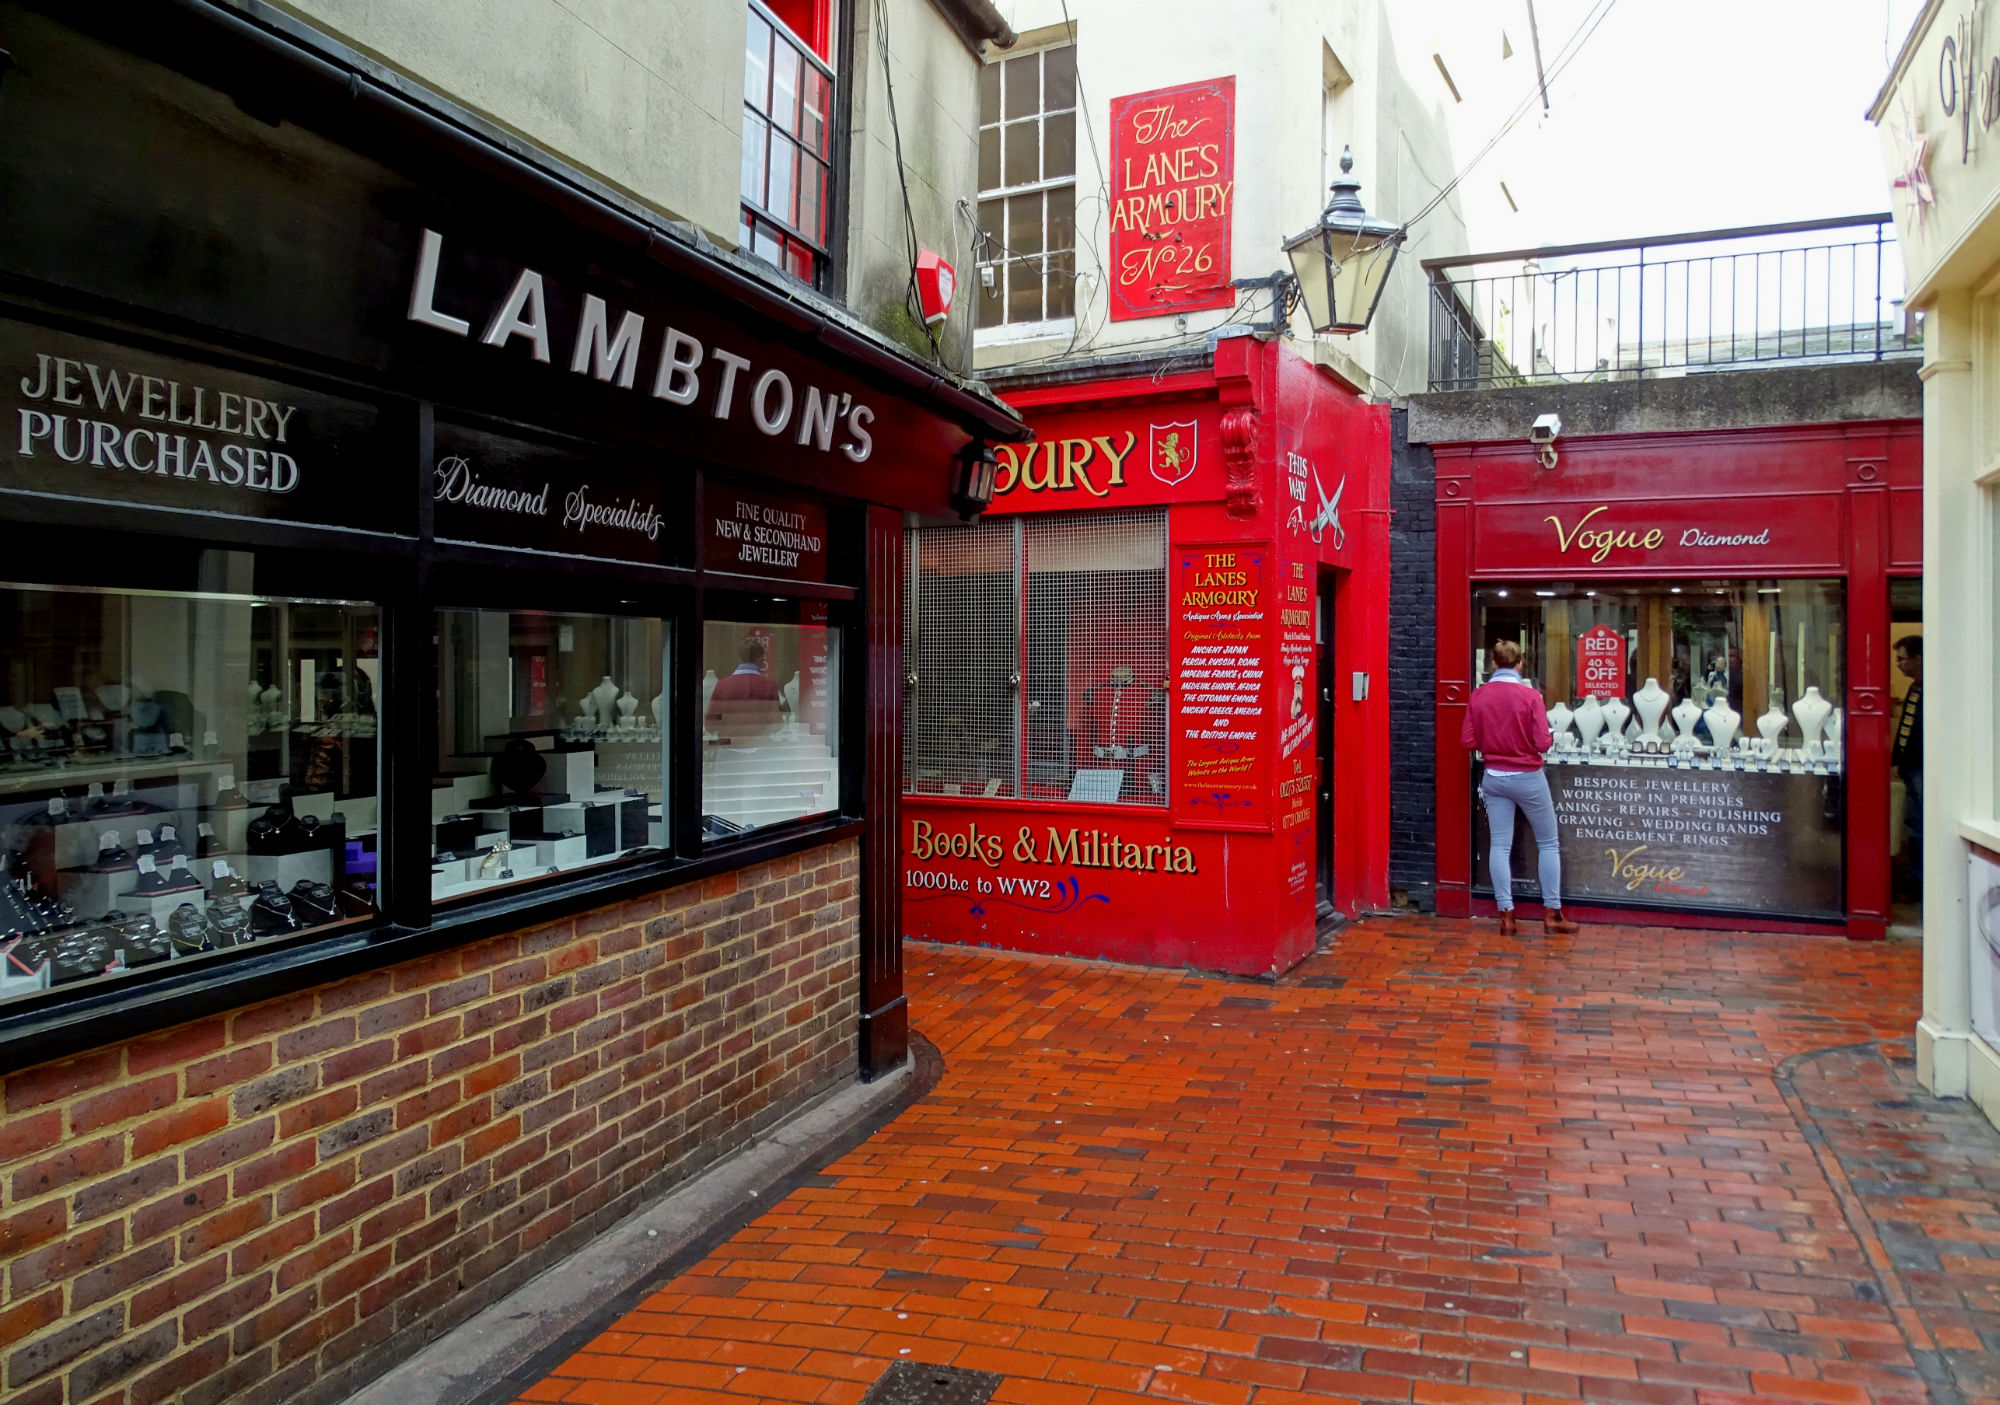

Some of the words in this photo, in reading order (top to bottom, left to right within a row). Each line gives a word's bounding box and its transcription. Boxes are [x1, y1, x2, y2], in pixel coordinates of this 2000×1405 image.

[1133, 105, 1212, 144] The
[1124, 144, 1219, 192] LANES
[1111, 181, 1233, 240] ARMOURY
[407, 227, 875, 464] LAMBTON'S
[20, 353, 296, 443] JEWELLERY
[17, 408, 300, 494] PURCHASED
[1287, 451, 1308, 478] THIS
[433, 455, 550, 516] Diamond
[563, 485, 665, 541] Specialists
[1288, 476, 1307, 503] WAY
[736, 501, 760, 521] FINE
[763, 507, 806, 531] QUALITY
[715, 518, 742, 538] NEW
[743, 523, 751, 541] &
[754, 526, 821, 553] SECONDHAND
[1543, 505, 1665, 564] Vogue
[1679, 527, 1770, 547] Diamond
[738, 544, 799, 568] JEWELLERY
[1205, 553, 1236, 568] THE
[1195, 572, 1247, 587] LANES
[1291, 562, 1304, 579] THE
[1182, 589, 1258, 609] ARMOURY
[1287, 584, 1308, 603] LANES
[1183, 611, 1210, 622] Antique
[1210, 610, 1232, 621] Arms
[1280, 608, 1311, 629] ARMOURY
[1184, 630, 1212, 642] Original
[1585, 637, 1618, 651] RED
[1191, 646, 1223, 654] ANCIENT
[1223, 646, 1249, 654] JAPAN
[1237, 658, 1260, 666] ROME
[1588, 658, 1602, 667] 40
[1605, 658, 1615, 667] %
[1180, 670, 1211, 678] IMPERIAL
[1211, 670, 1238, 678] FRANCE
[1242, 670, 1264, 678] CHINA
[1585, 667, 1618, 680] OFF
[1180, 682, 1211, 690] MEDIEVAL
[1237, 683, 1261, 691] AFRICA
[1183, 693, 1197, 702] THE
[1197, 694, 1231, 702] OTTOMAN
[1231, 694, 1259, 703] EMPIRE
[1180, 706, 1209, 714] ANCIENT
[1234, 707, 1262, 715] AMERICA
[1213, 718, 1230, 727] AND
[1185, 730, 1200, 739] THE
[1200, 730, 1228, 739] BRITISH
[1228, 731, 1257, 740] EMPIRE
[1574, 777, 1637, 790] BESPOKE
[1644, 779, 1730, 793] JEWELLERY
[1562, 789, 1642, 803] WORKSHOP
[1648, 793, 1663, 803] IN
[1671, 793, 1744, 807] PREMISES
[1553, 801, 1600, 813] ANING
[1619, 804, 1679, 817] REPAIRS
[1698, 808, 1782, 823] POLISHING
[1641, 818, 1712, 832] WEDDING
[1717, 823, 1768, 836] BANDS
[911, 819, 1003, 868] Books
[1012, 825, 1038, 863] &
[1044, 826, 1198, 874] Militaria
[1576, 828, 1675, 843] ENGAGEMENT
[1683, 834, 1728, 847] RINGS
[1604, 845, 1686, 890] Vogue
[977, 877, 993, 894] to
[997, 877, 1051, 899] WW2
